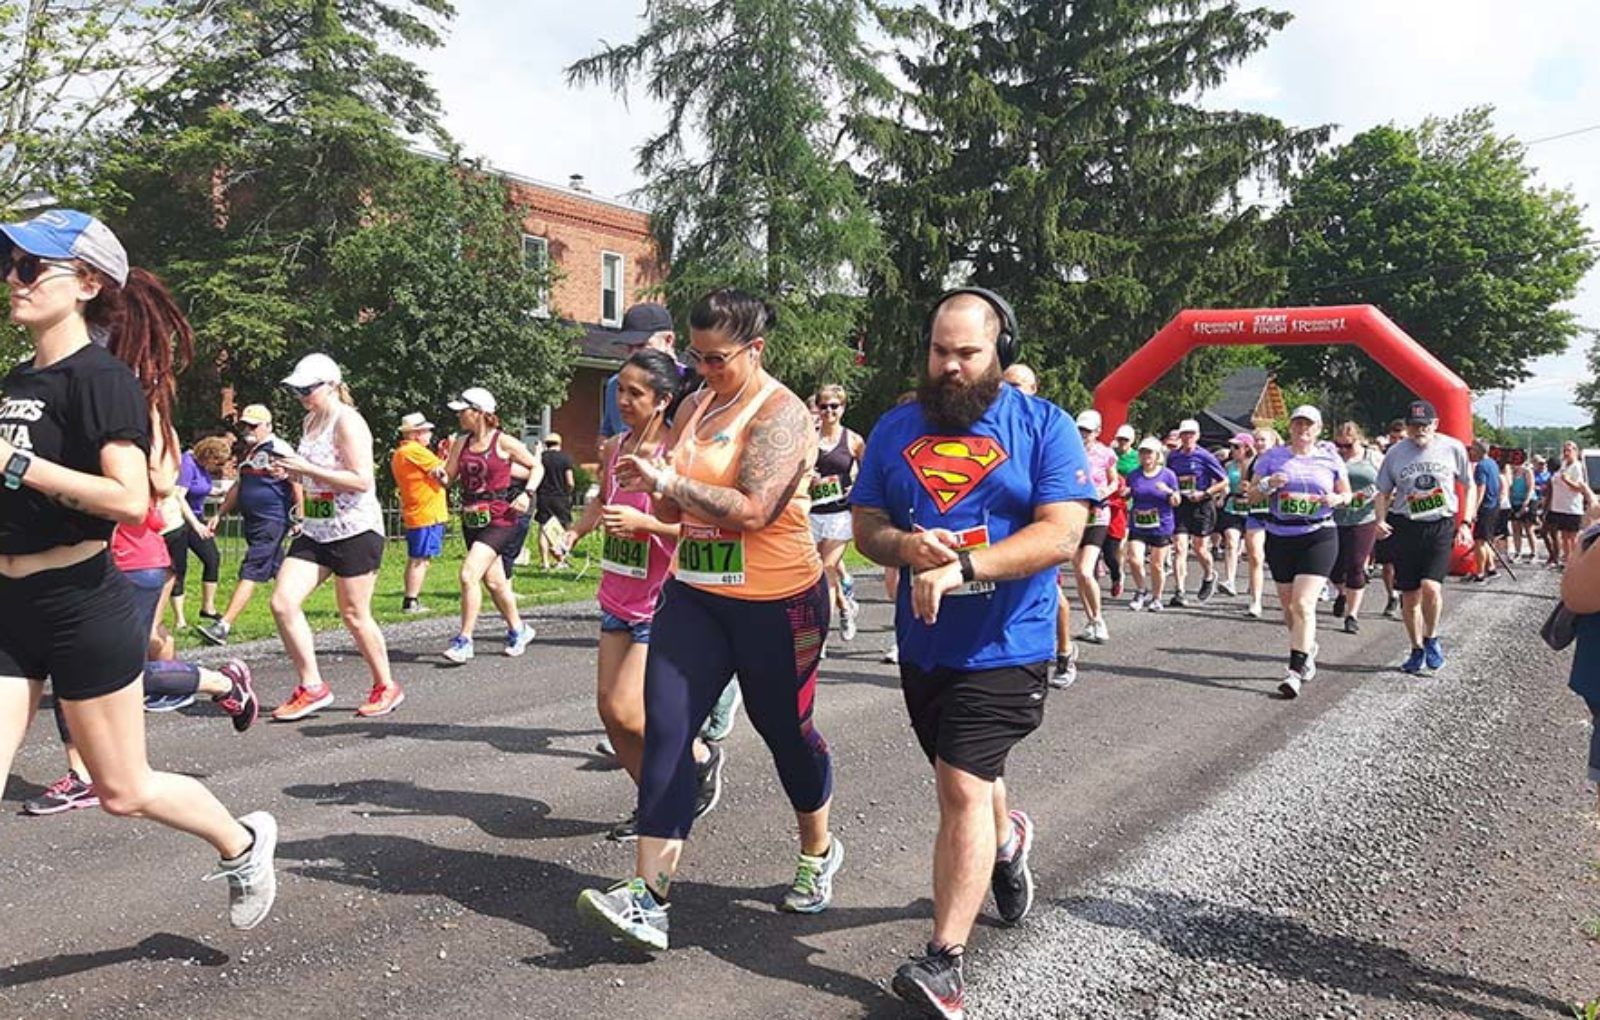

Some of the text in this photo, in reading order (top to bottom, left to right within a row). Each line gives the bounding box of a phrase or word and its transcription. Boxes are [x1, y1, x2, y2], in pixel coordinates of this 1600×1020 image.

[1253, 314, 1287, 323] START
[603, 535, 642, 567] 4094
[679, 540, 736, 572] 4017
[722, 574, 742, 583] 4017
